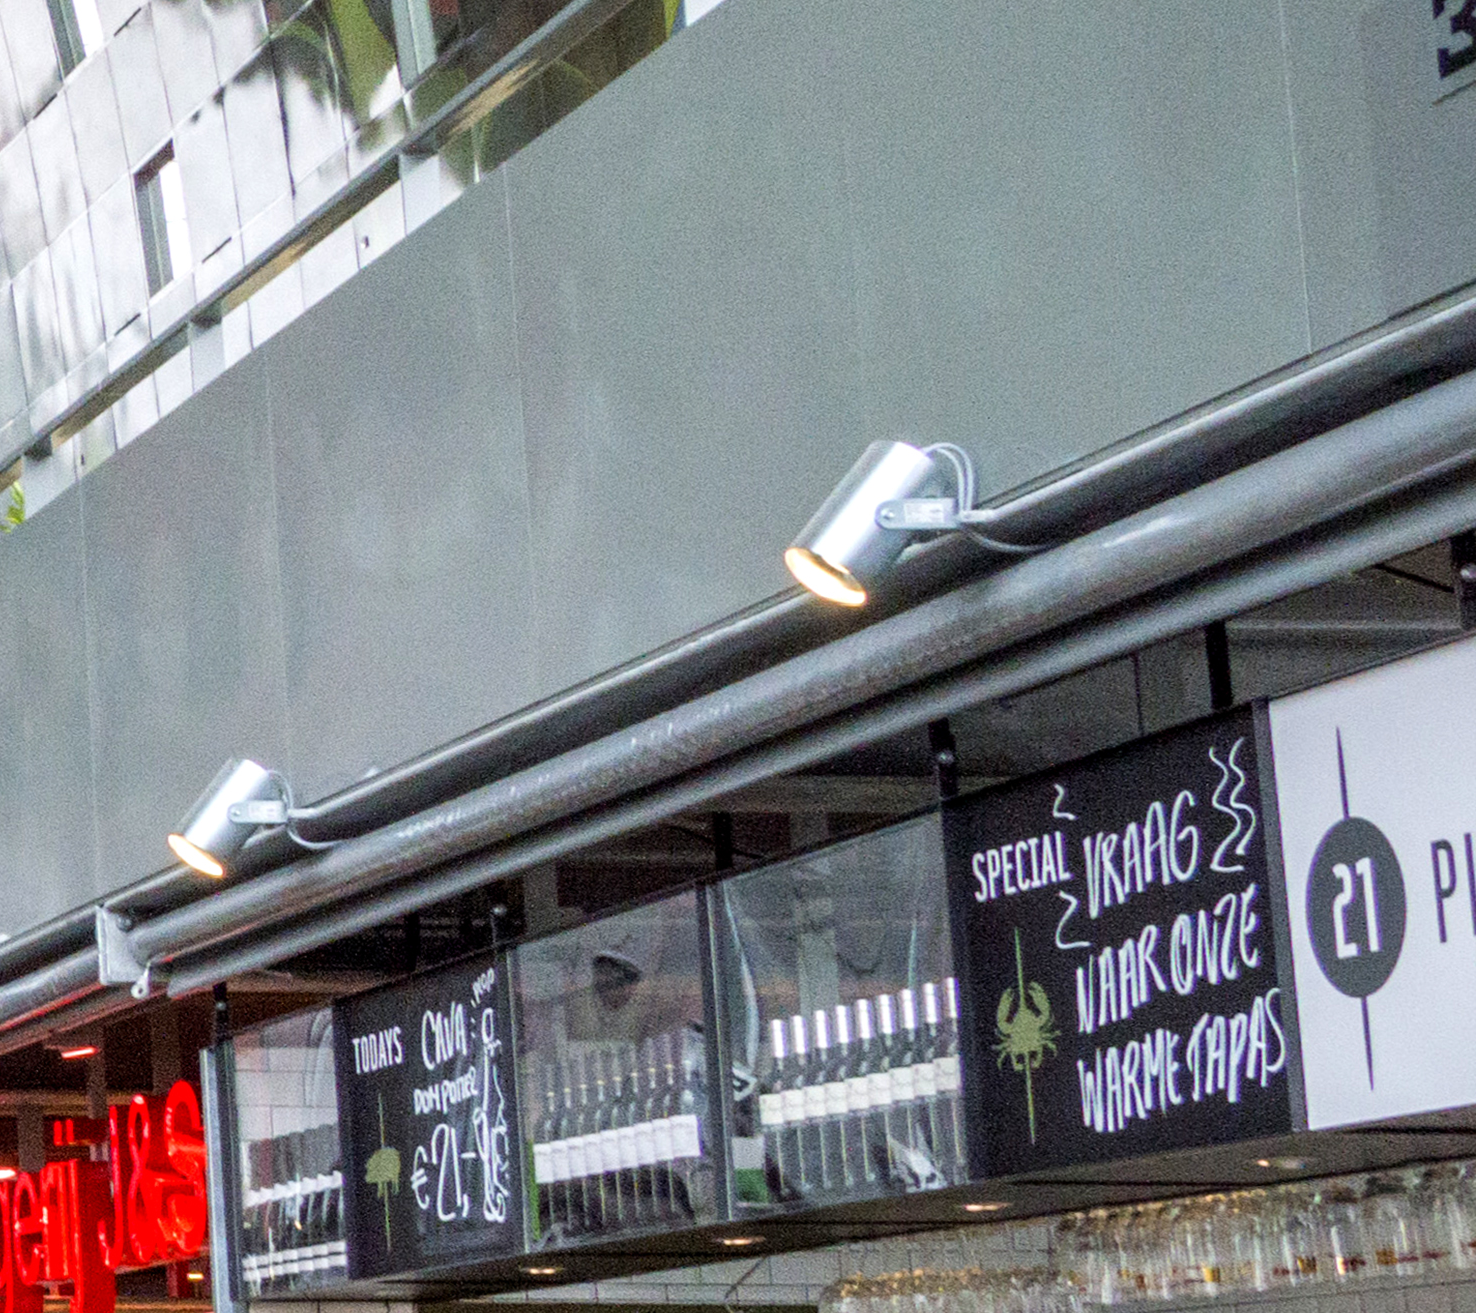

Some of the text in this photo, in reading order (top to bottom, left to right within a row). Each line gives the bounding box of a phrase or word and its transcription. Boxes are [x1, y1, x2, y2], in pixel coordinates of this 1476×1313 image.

[973, 832, 1071, 902] SPECIAL
[1083, 789, 1199, 919] VRAAG
[1075, 883, 1260, 1034] NAAR ONZE
[1331, 856, 1382, 959] 21
[352, 1026, 404, 1075] TODAYS
[421, 1001, 468, 1071] CAVA
[1077, 988, 1285, 1134] WARME TAPAS
